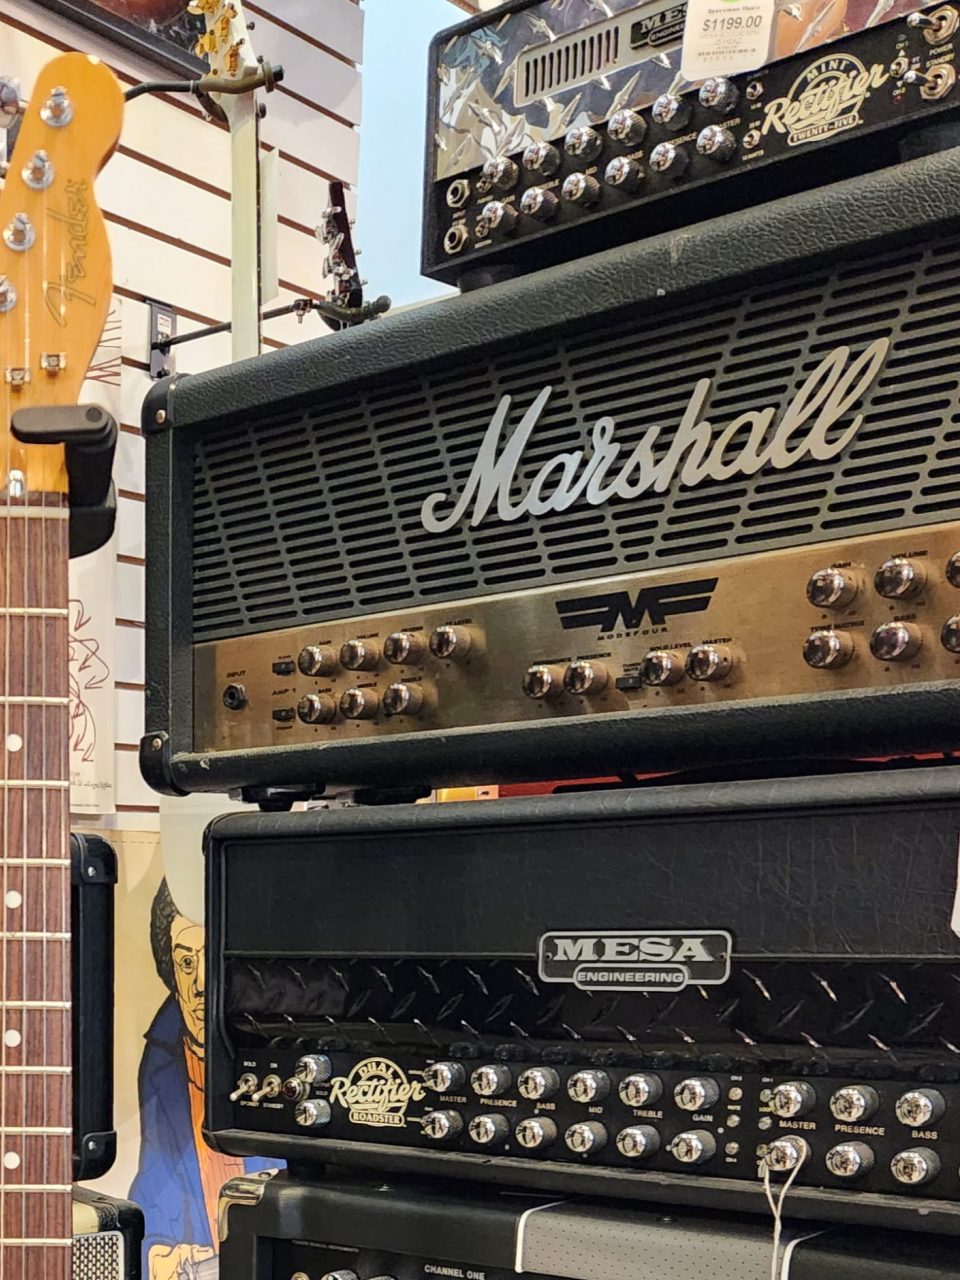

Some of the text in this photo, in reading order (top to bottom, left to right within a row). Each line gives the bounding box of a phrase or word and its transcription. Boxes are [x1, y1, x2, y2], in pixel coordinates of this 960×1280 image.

[640, 4, 687, 33] ME
[702, 15, 763, 31] $1199.00
[761, 63, 889, 135] Rectifier
[45, 178, 96, 328] Fender
[420, 337, 890, 533] Marshall
[597, 627, 669, 641] MODEFOUR
[227, 670, 246, 678] INPUT
[553, 937, 715, 962] MESA
[577, 971, 684, 983] ENGINEERING
[358, 1062, 395, 1078] DUAL
[329, 1077, 427, 1112] Rectifier
[439, 1095, 467, 1103] MASTER
[480, 1098, 518, 1108] PRESENCE
[536, 1102, 556, 1111] BASS
[589, 1106, 603, 1114] MID
[632, 1109, 664, 1119] TREBLE
[352, 1112, 401, 1125] ROADSTER
[692, 1113, 713, 1123] GAIN
[779, 1121, 816, 1131] MASTER
[834, 1124, 886, 1136] PRESENCE
[911, 1130, 938, 1140] BASS
[424, 1264, 486, 1280] CHANNEL ONE
